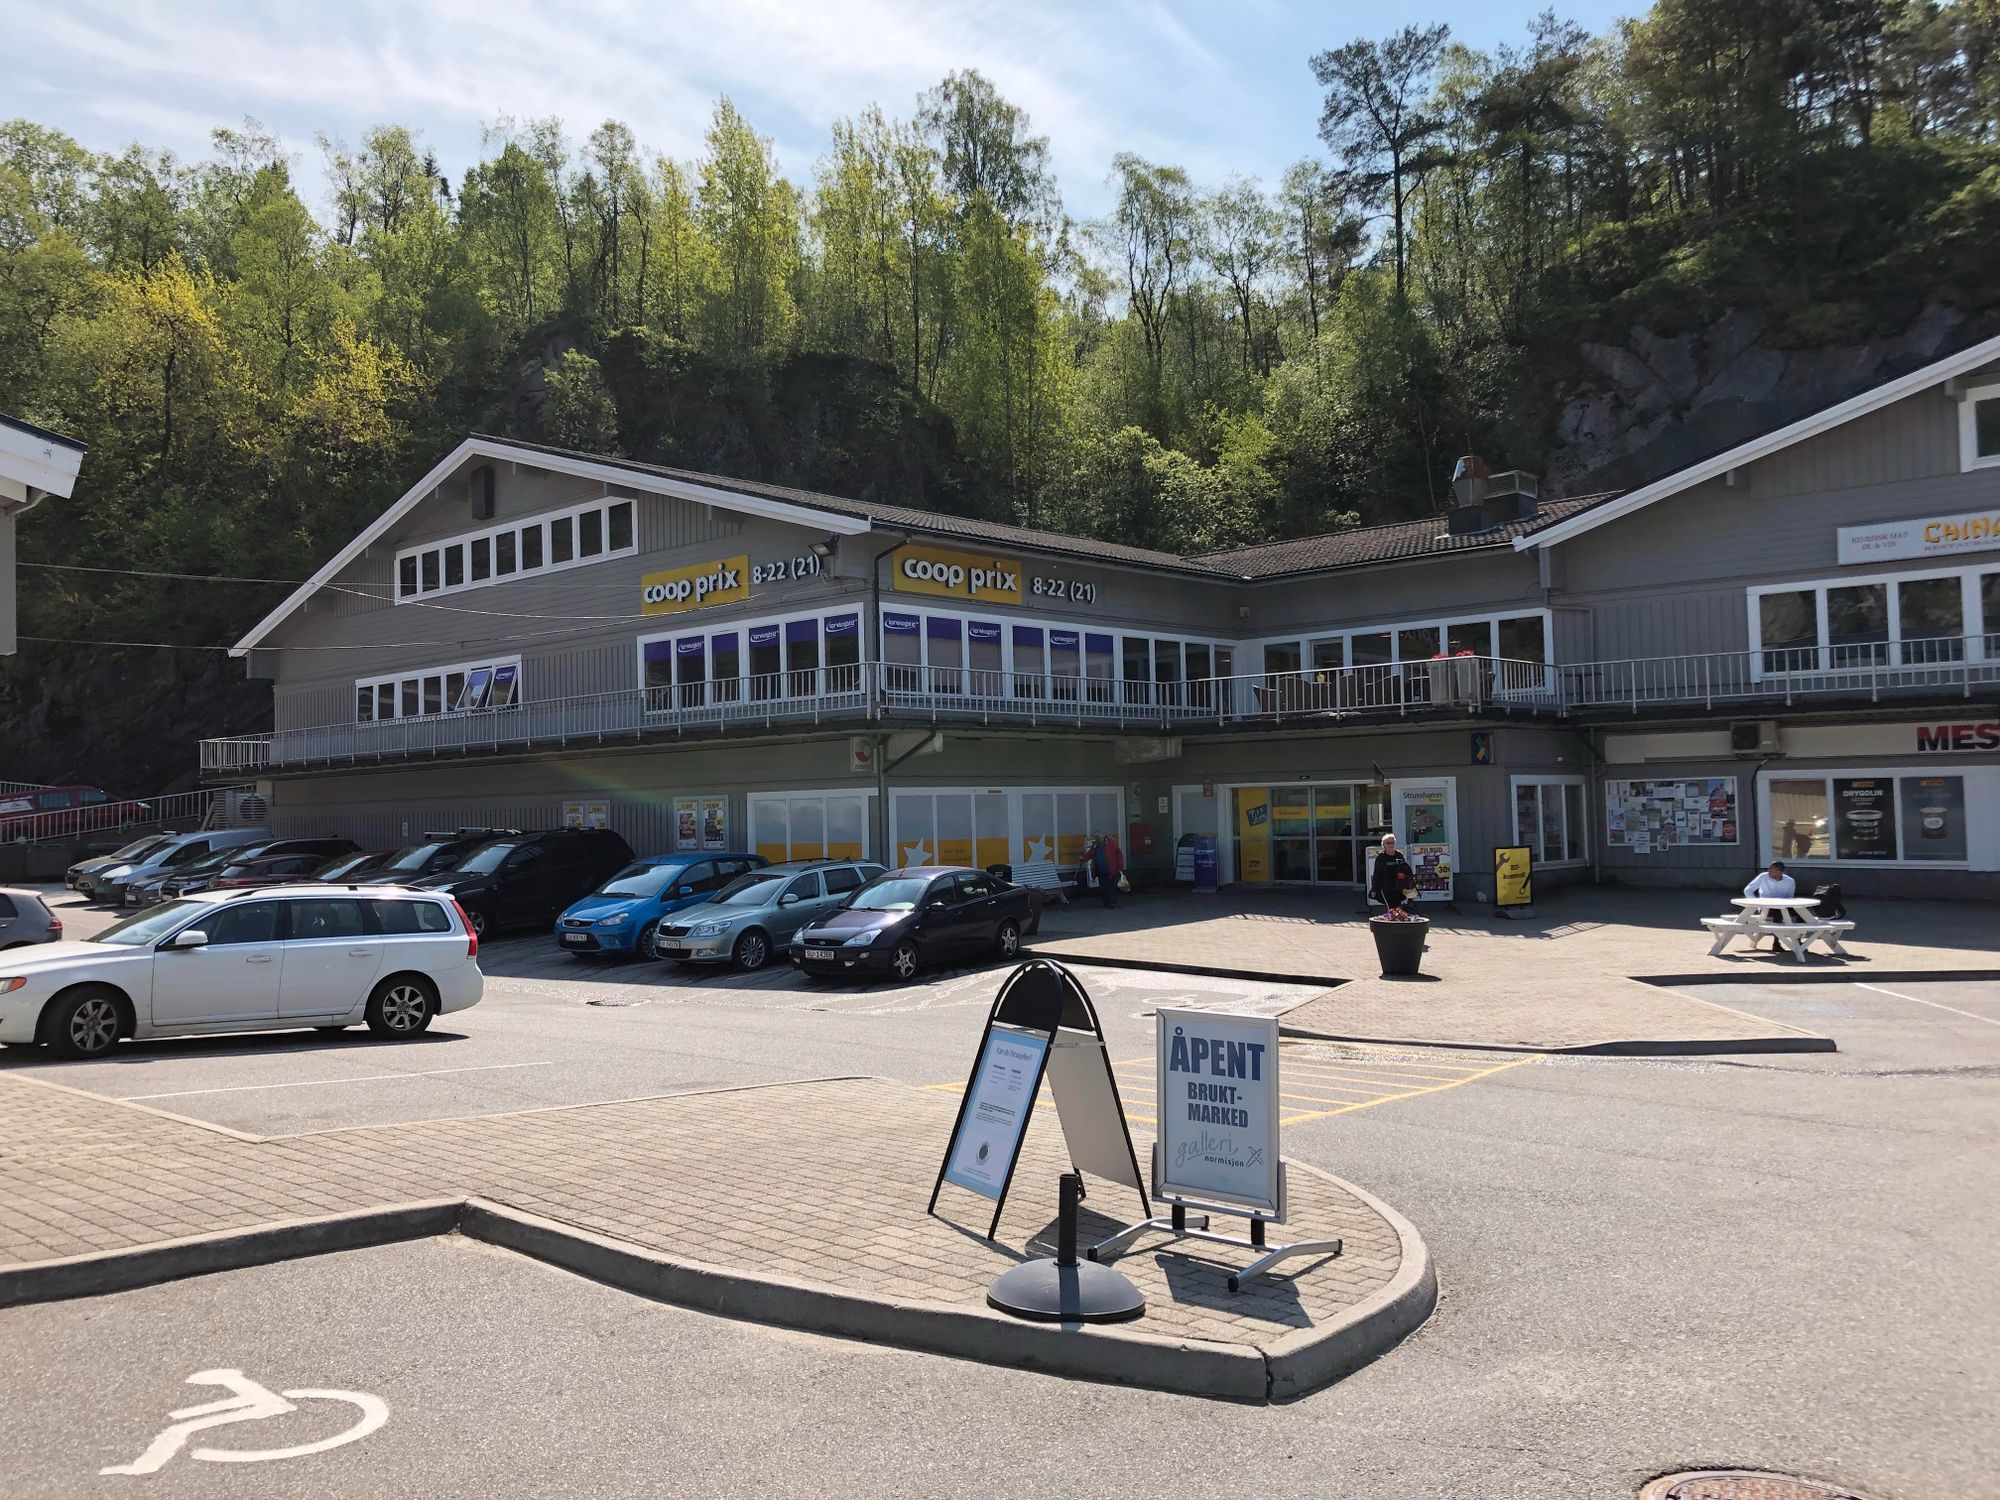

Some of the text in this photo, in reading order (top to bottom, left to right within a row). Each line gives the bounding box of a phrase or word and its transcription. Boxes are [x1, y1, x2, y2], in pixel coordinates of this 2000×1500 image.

[643, 563, 739, 603] coop prix
[752, 554, 821, 584] 8-22 (21)
[903, 558, 1017, 594] coop prix
[1032, 576, 1097, 604] 8-22 (21)
[1916, 722, 2000, 752] MES
[1842, 789, 1884, 797] DRYGOLIN
[1169, 1026, 1266, 1081] ÅPENT
[1187, 1081, 1243, 1105] BRUKT-
[1187, 1103, 1249, 1129] MARKED
[1204, 1155, 1245, 1168] normisjon
